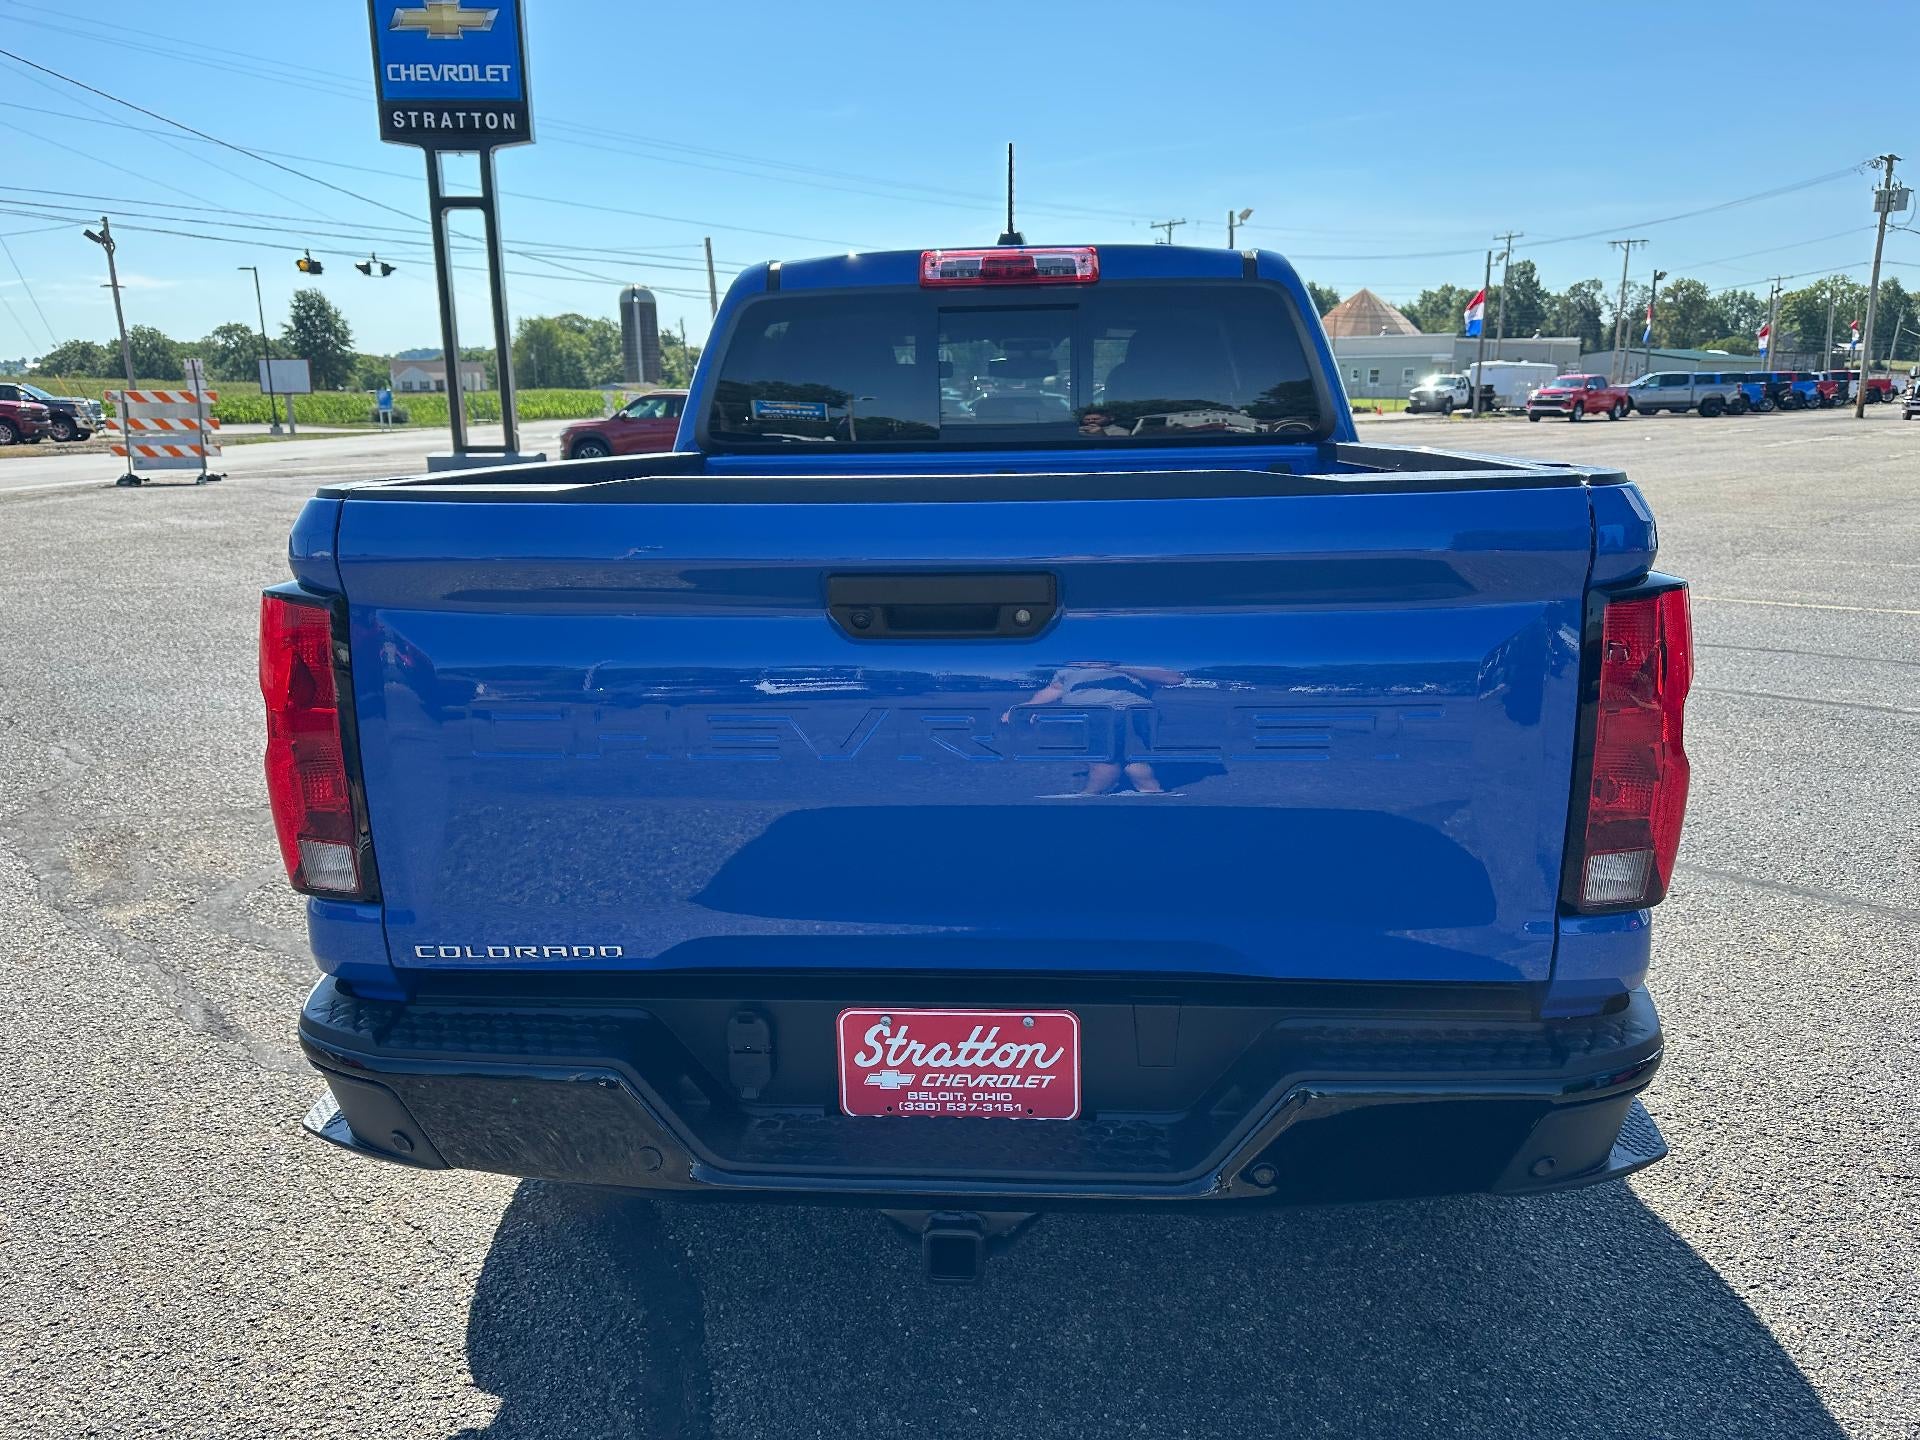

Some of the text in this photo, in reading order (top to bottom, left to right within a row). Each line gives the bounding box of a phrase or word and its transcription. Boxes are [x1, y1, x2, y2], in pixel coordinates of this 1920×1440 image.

[387, 63, 511, 82] CHEVROLET
[392, 110, 516, 130] STRATTON
[469, 704, 1446, 762] CHEVROLET
[414, 945, 623, 958] COLORADO
[853, 1023, 1064, 1069] Stratton
[921, 1073, 1056, 1089] CHEVROLET
[907, 1091, 1013, 1102] BELOIT, OHIO
[898, 1101, 1022, 1112] (330) 537-3151
